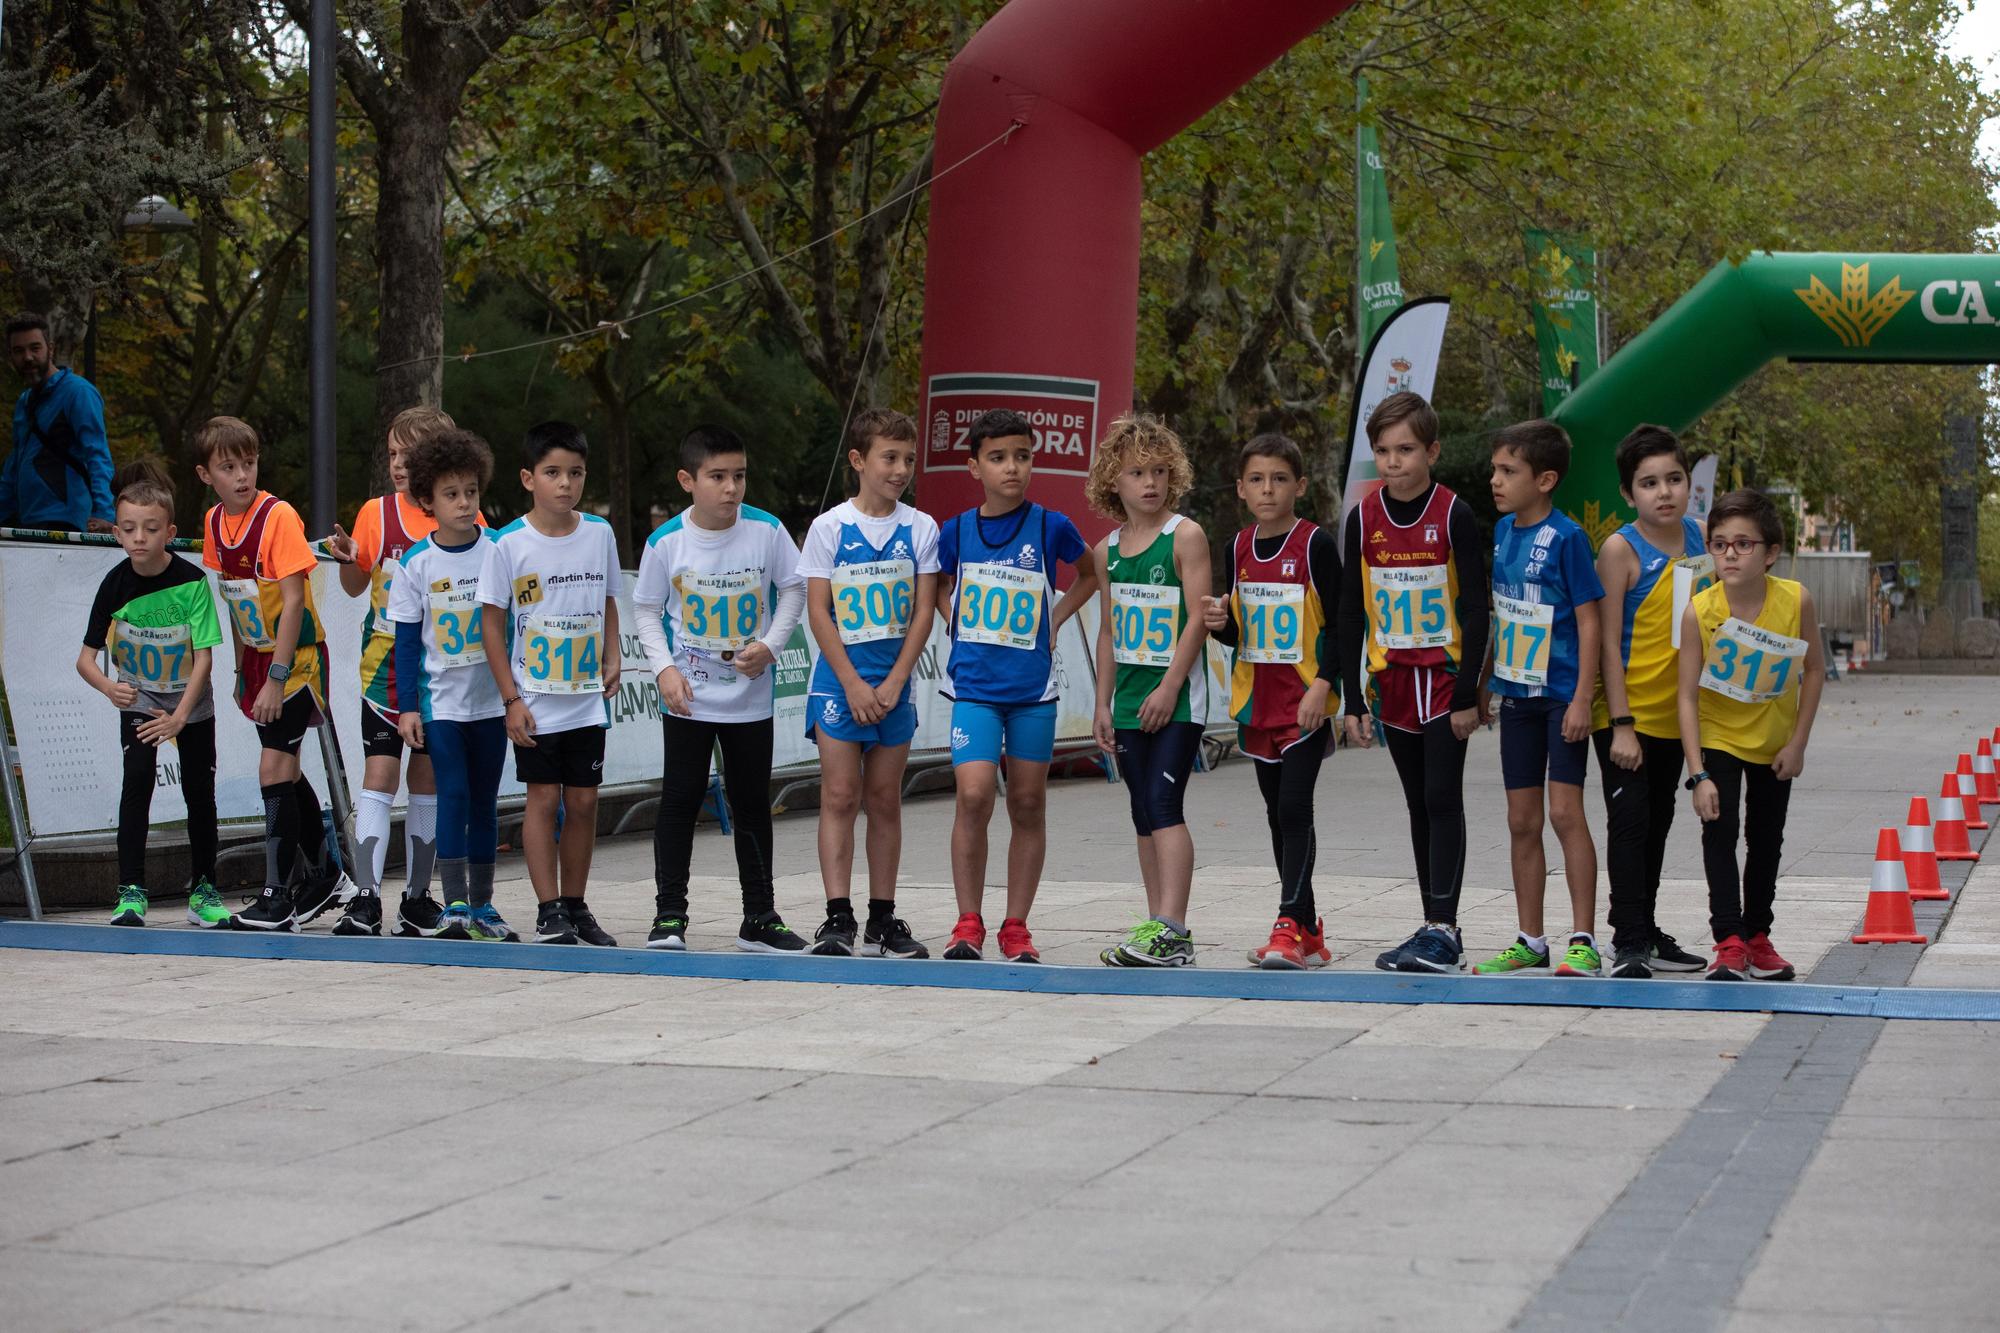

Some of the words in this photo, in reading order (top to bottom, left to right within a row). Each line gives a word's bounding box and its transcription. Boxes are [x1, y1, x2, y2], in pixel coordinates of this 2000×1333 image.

[1921, 279, 2000, 327] CA
[953, 427, 1085, 457] ZORA
[955, 408, 1058, 428] DIPIÓN
[1063, 415, 1085, 429] DE
[686, 592, 758, 638] 318
[838, 581, 911, 631] 306
[961, 584, 1036, 636] 308
[1112, 603, 1173, 653] 305
[1375, 588, 1446, 635] 315
[117, 640, 187, 682] 307
[529, 634, 599, 681] 314
[1709, 637, 1793, 693] 311
